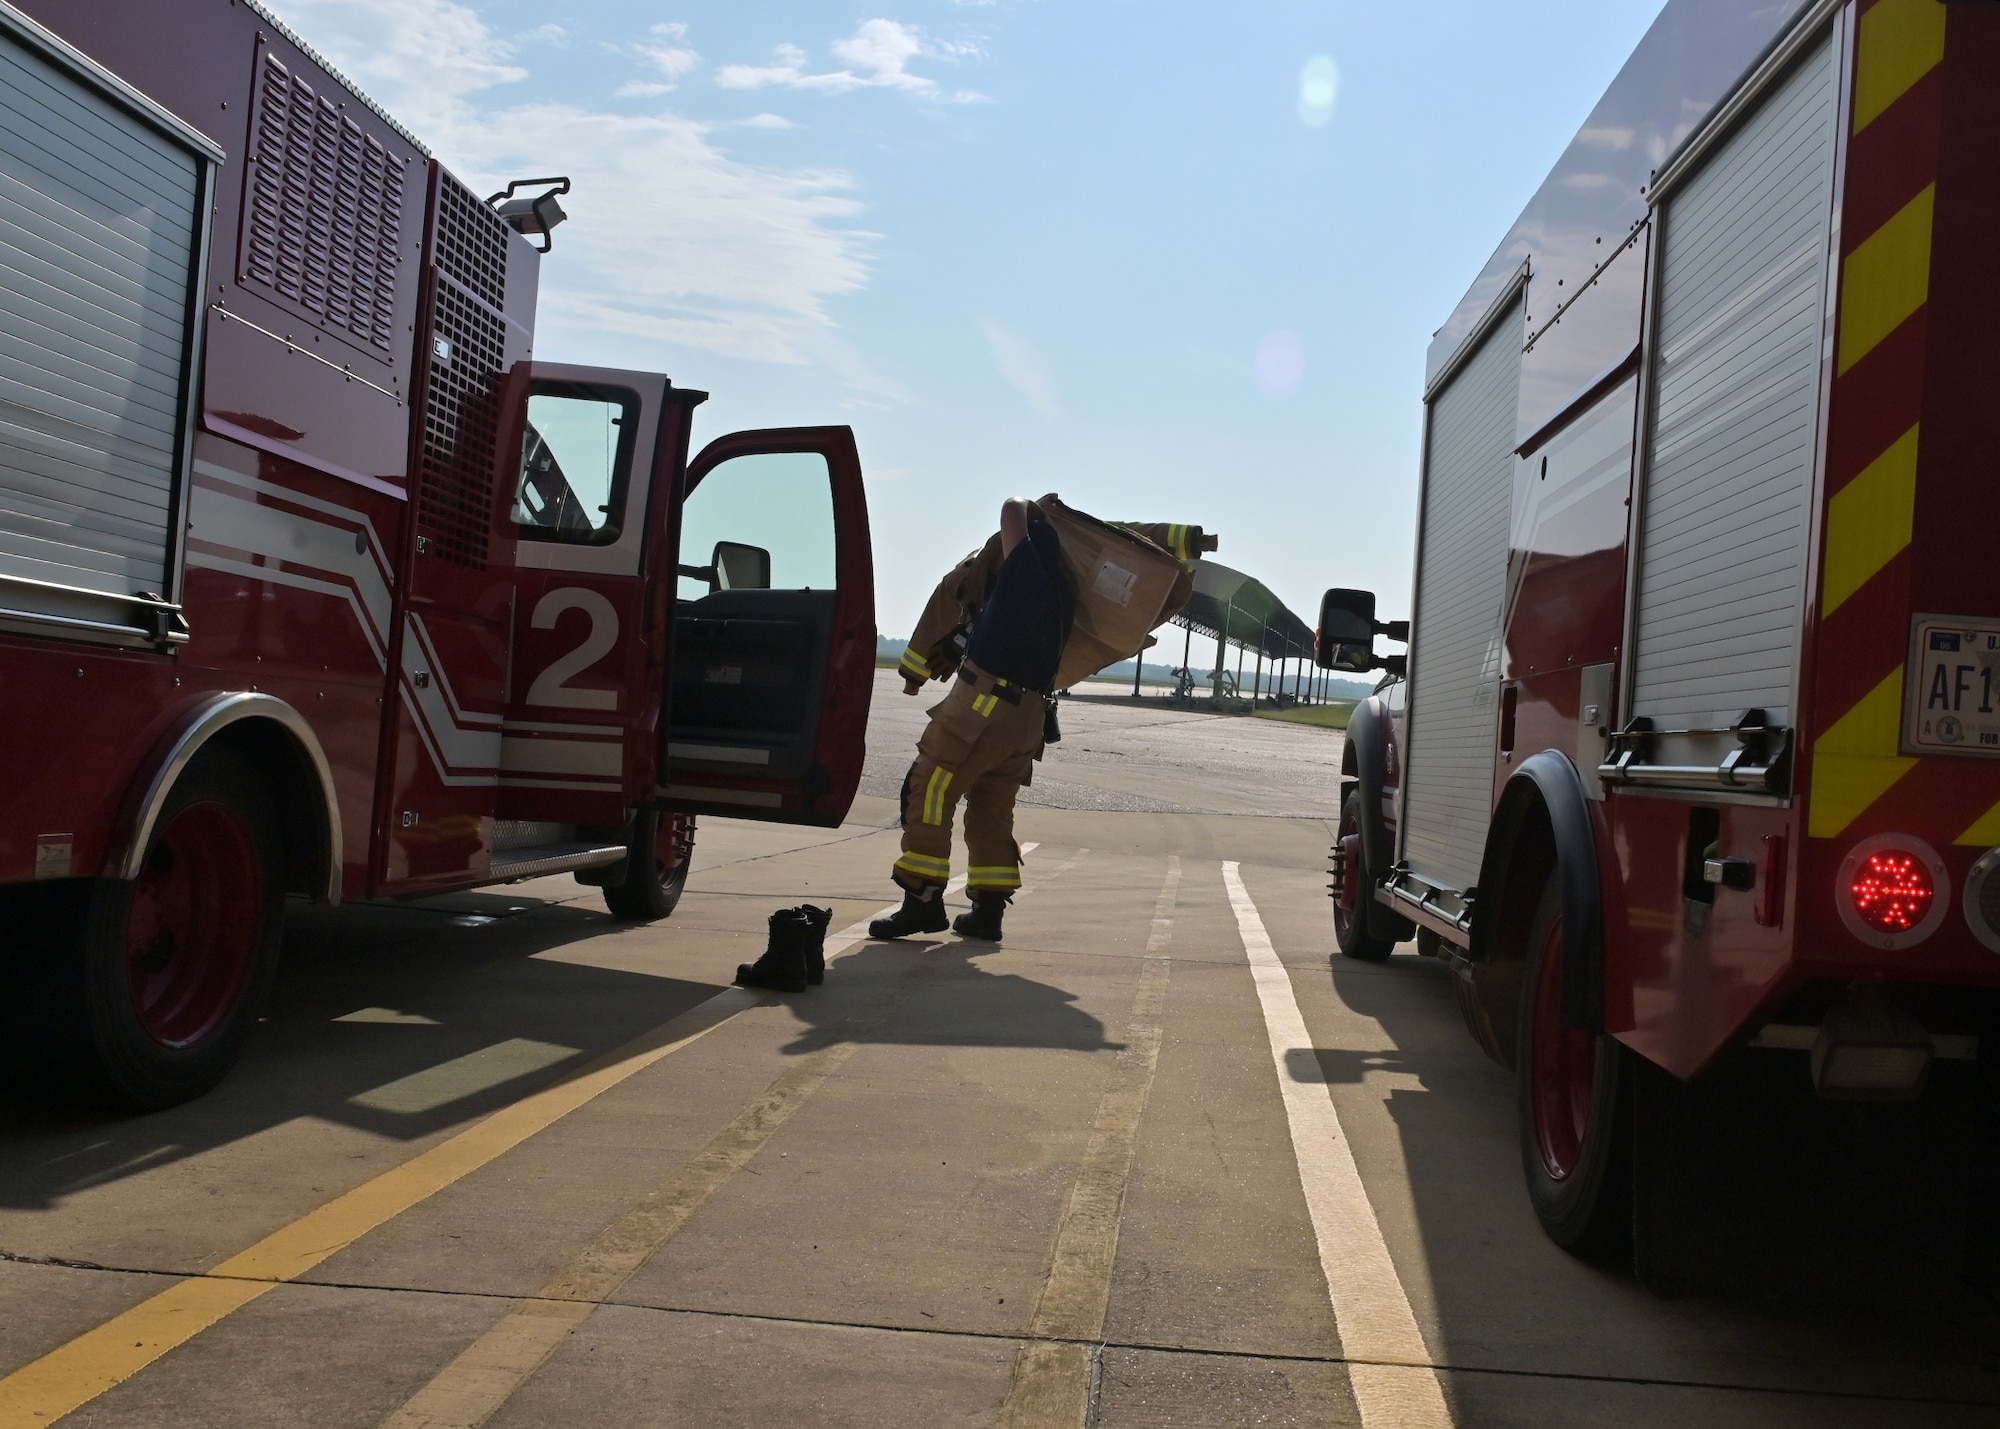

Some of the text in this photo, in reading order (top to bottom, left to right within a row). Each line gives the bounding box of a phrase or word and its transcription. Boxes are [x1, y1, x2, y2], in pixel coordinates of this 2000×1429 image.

[525, 586, 620, 711] 2
[1987, 635, 2000, 651] U.
[1924, 720, 1931, 735] A
[1980, 732, 1999, 745] FOR
